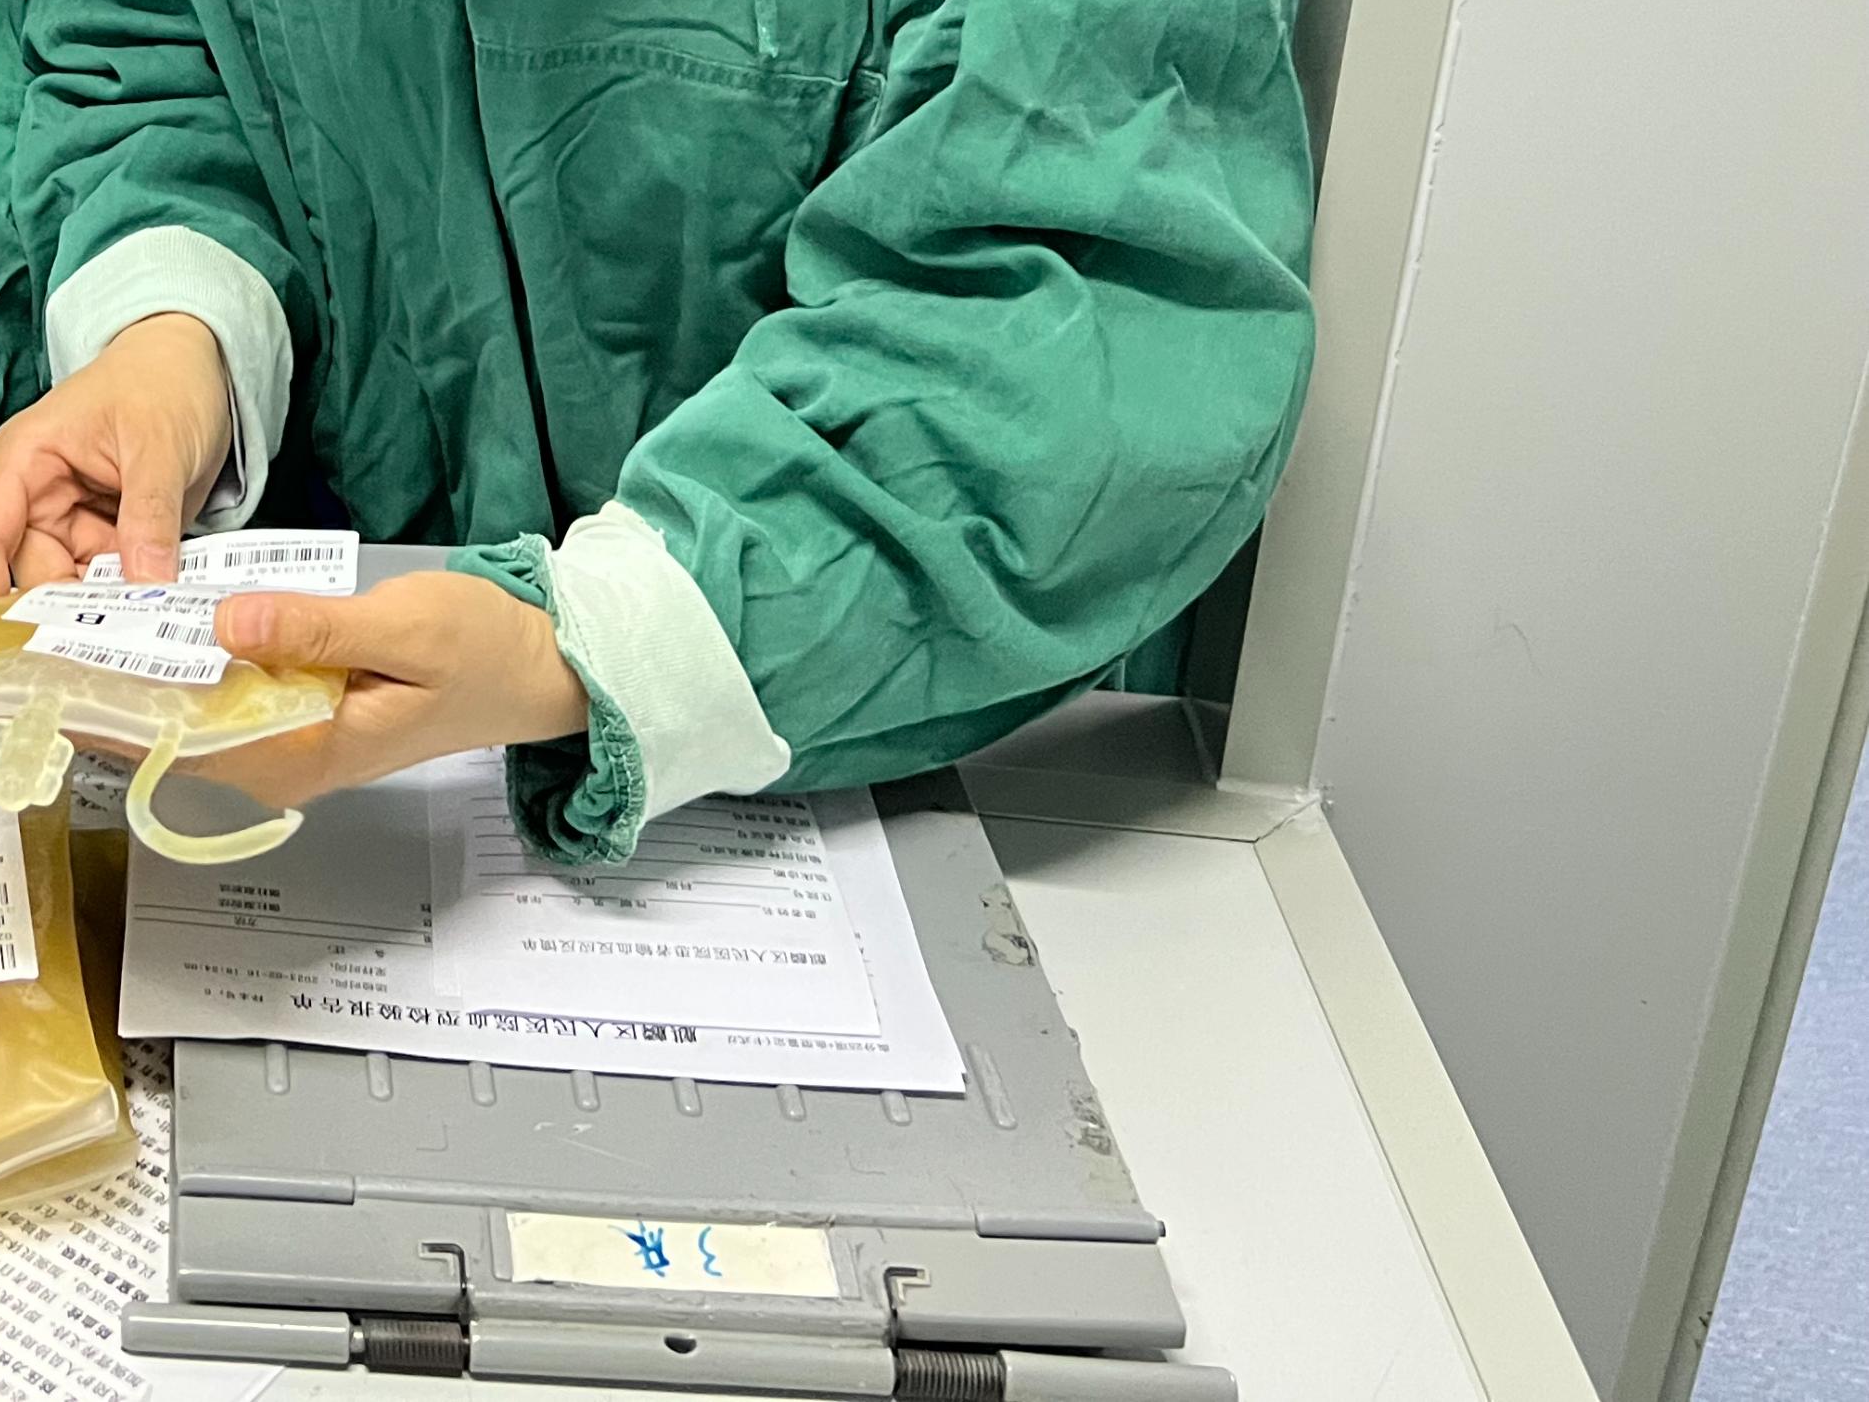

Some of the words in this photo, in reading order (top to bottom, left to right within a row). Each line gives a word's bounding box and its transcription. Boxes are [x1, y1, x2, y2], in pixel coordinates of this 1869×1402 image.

[75, 611, 106, 626] B
[287, 991, 699, 1047] 麒麟区人民医院血型检验报告单
